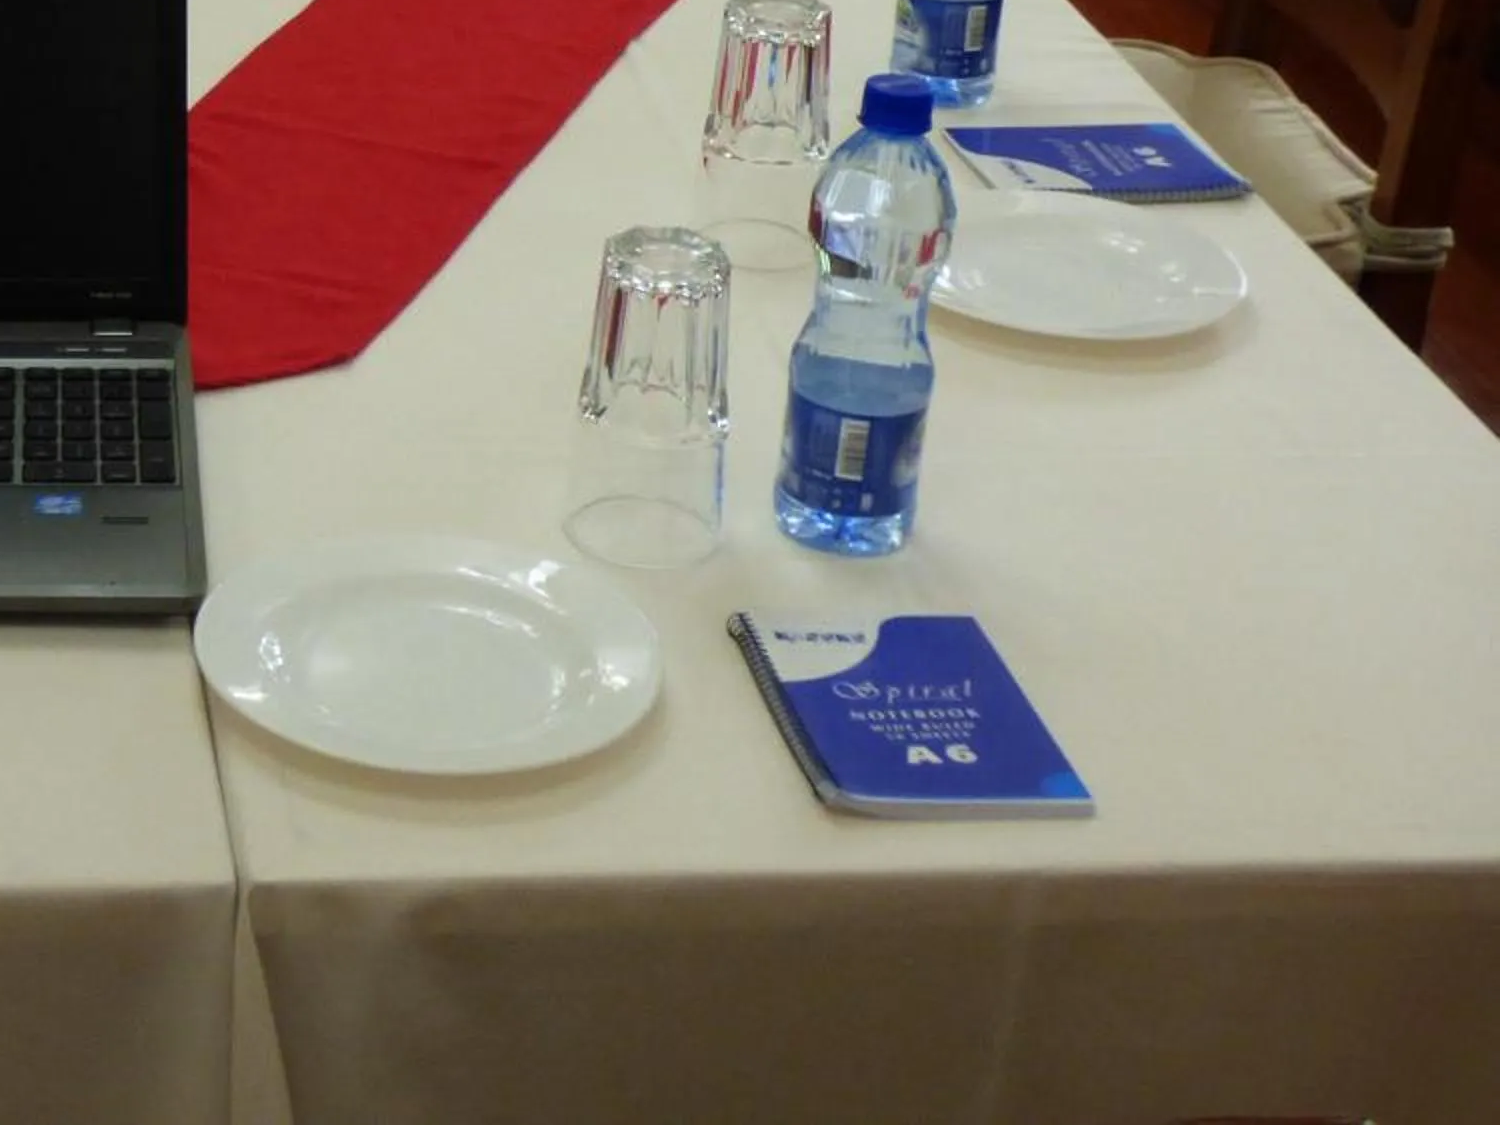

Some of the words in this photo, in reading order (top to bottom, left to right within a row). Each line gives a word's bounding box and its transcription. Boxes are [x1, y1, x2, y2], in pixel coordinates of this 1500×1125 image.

[833, 679, 972, 703] Spiral
[849, 707, 981, 722] NOTEBOOK
[907, 743, 979, 764] A6
